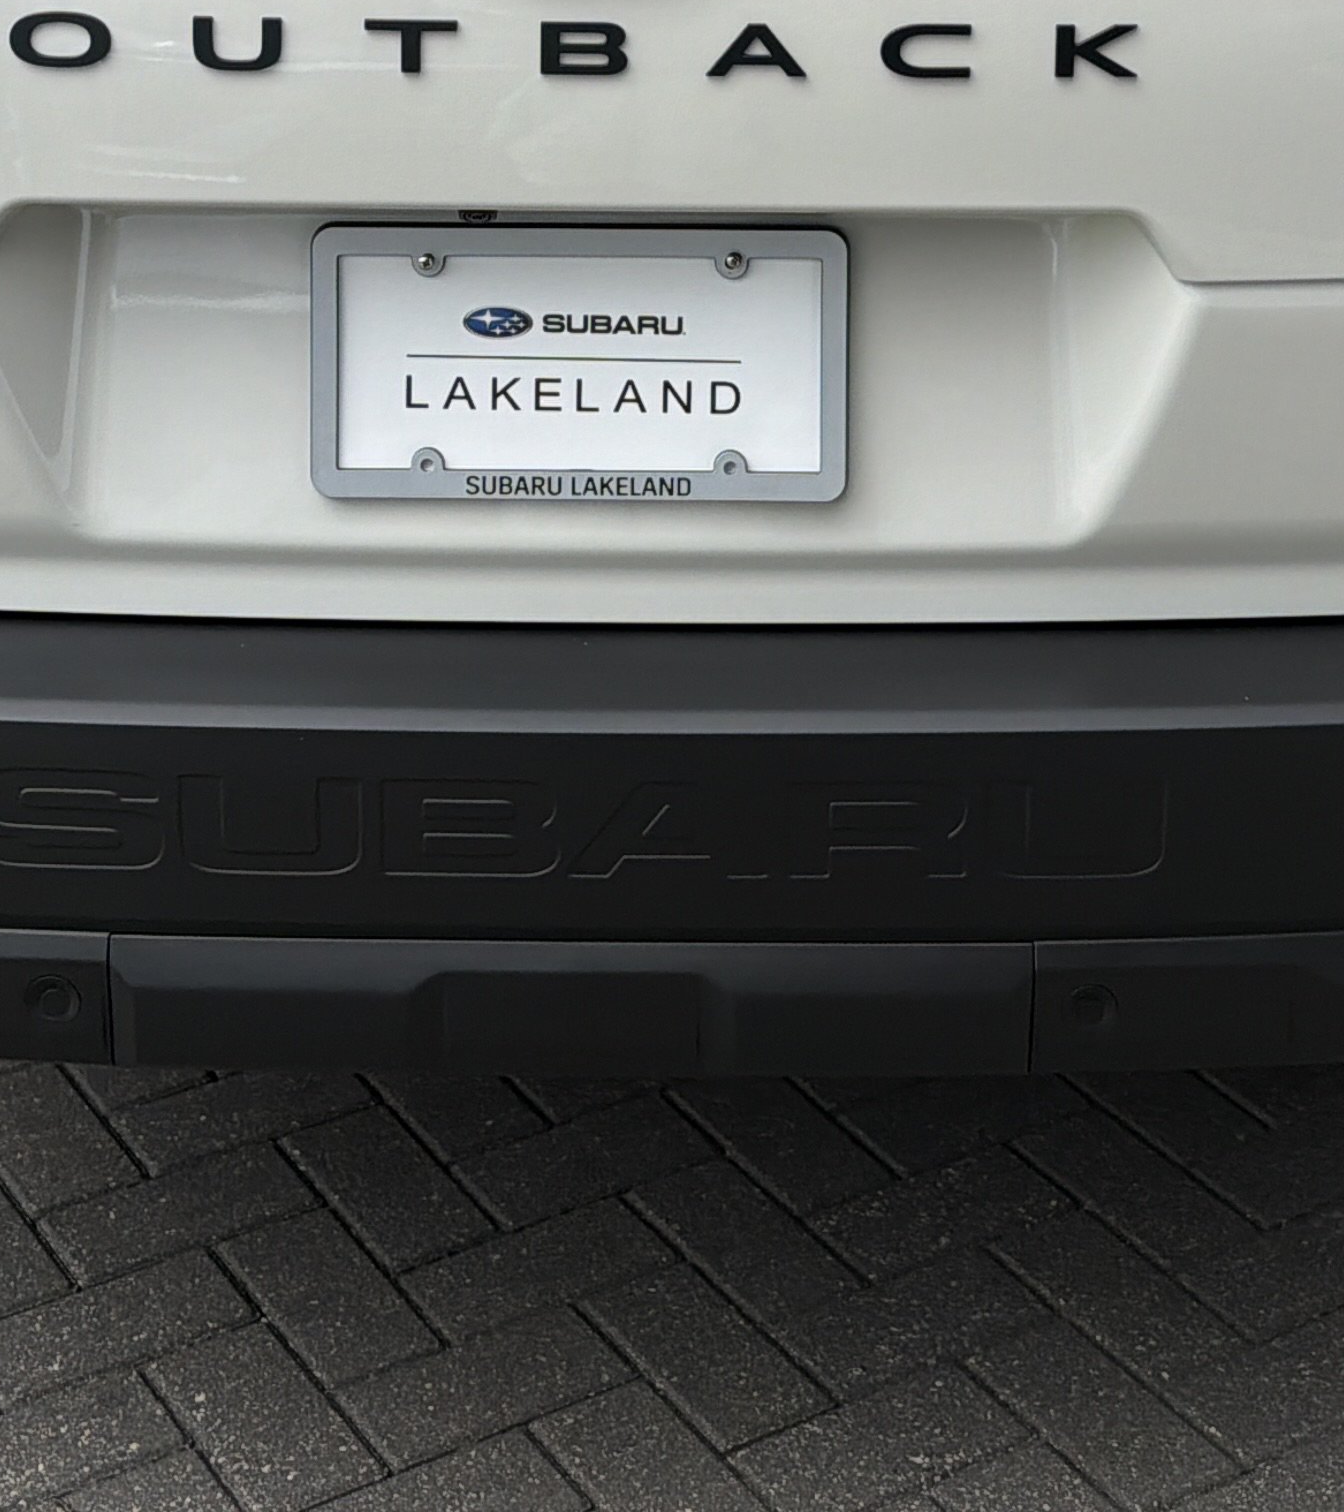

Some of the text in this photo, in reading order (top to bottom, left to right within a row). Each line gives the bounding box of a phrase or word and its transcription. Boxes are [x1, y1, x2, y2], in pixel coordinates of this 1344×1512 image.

[8, 10, 1139, 80] OUTBACK
[541, 313, 683, 336] SUBARU
[405, 374, 742, 416] LAKELAND
[465, 474, 692, 498] SUBARU LAKELAND
